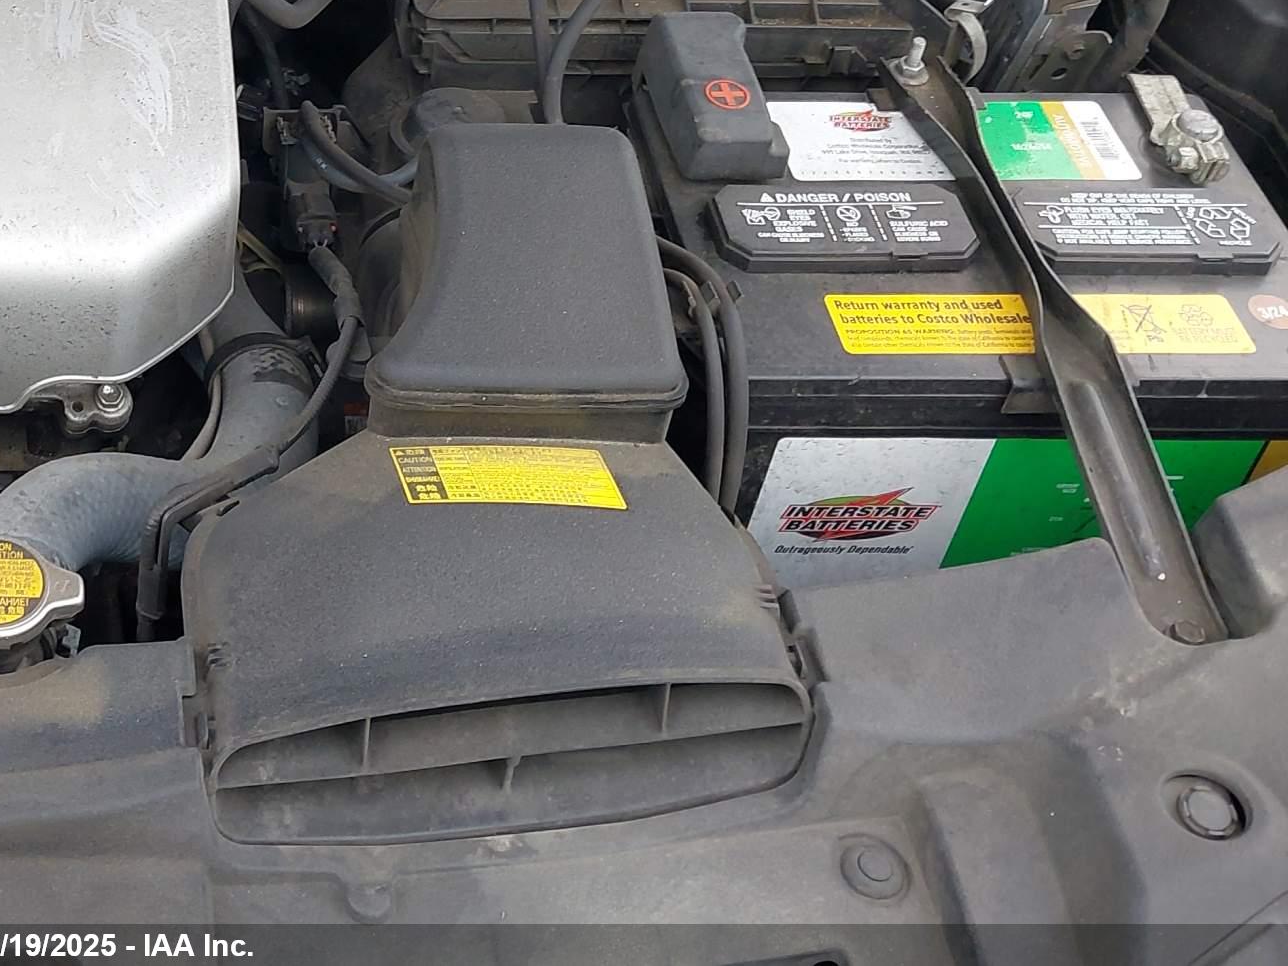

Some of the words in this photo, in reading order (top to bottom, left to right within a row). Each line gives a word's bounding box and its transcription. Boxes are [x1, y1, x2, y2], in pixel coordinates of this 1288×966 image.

[775, 193, 839, 203] DANGER
[842, 193, 851, 203] /
[854, 192, 912, 202] POISON
[834, 300, 879, 311] Return
[882, 300, 940, 312] warranty
[943, 299, 969, 311] and
[971, 299, 1003, 310] used
[840, 313, 899, 324] batteries
[902, 314, 914, 324] to
[916, 314, 959, 324] Costco
[962, 314, 1031, 324] Wholesale
[784, 506, 934, 518] INTERSTATE
[785, 519, 916, 531] BATTERIES
[774, 545, 845, 554] Outrageously
[847, 545, 911, 554] Dependable
